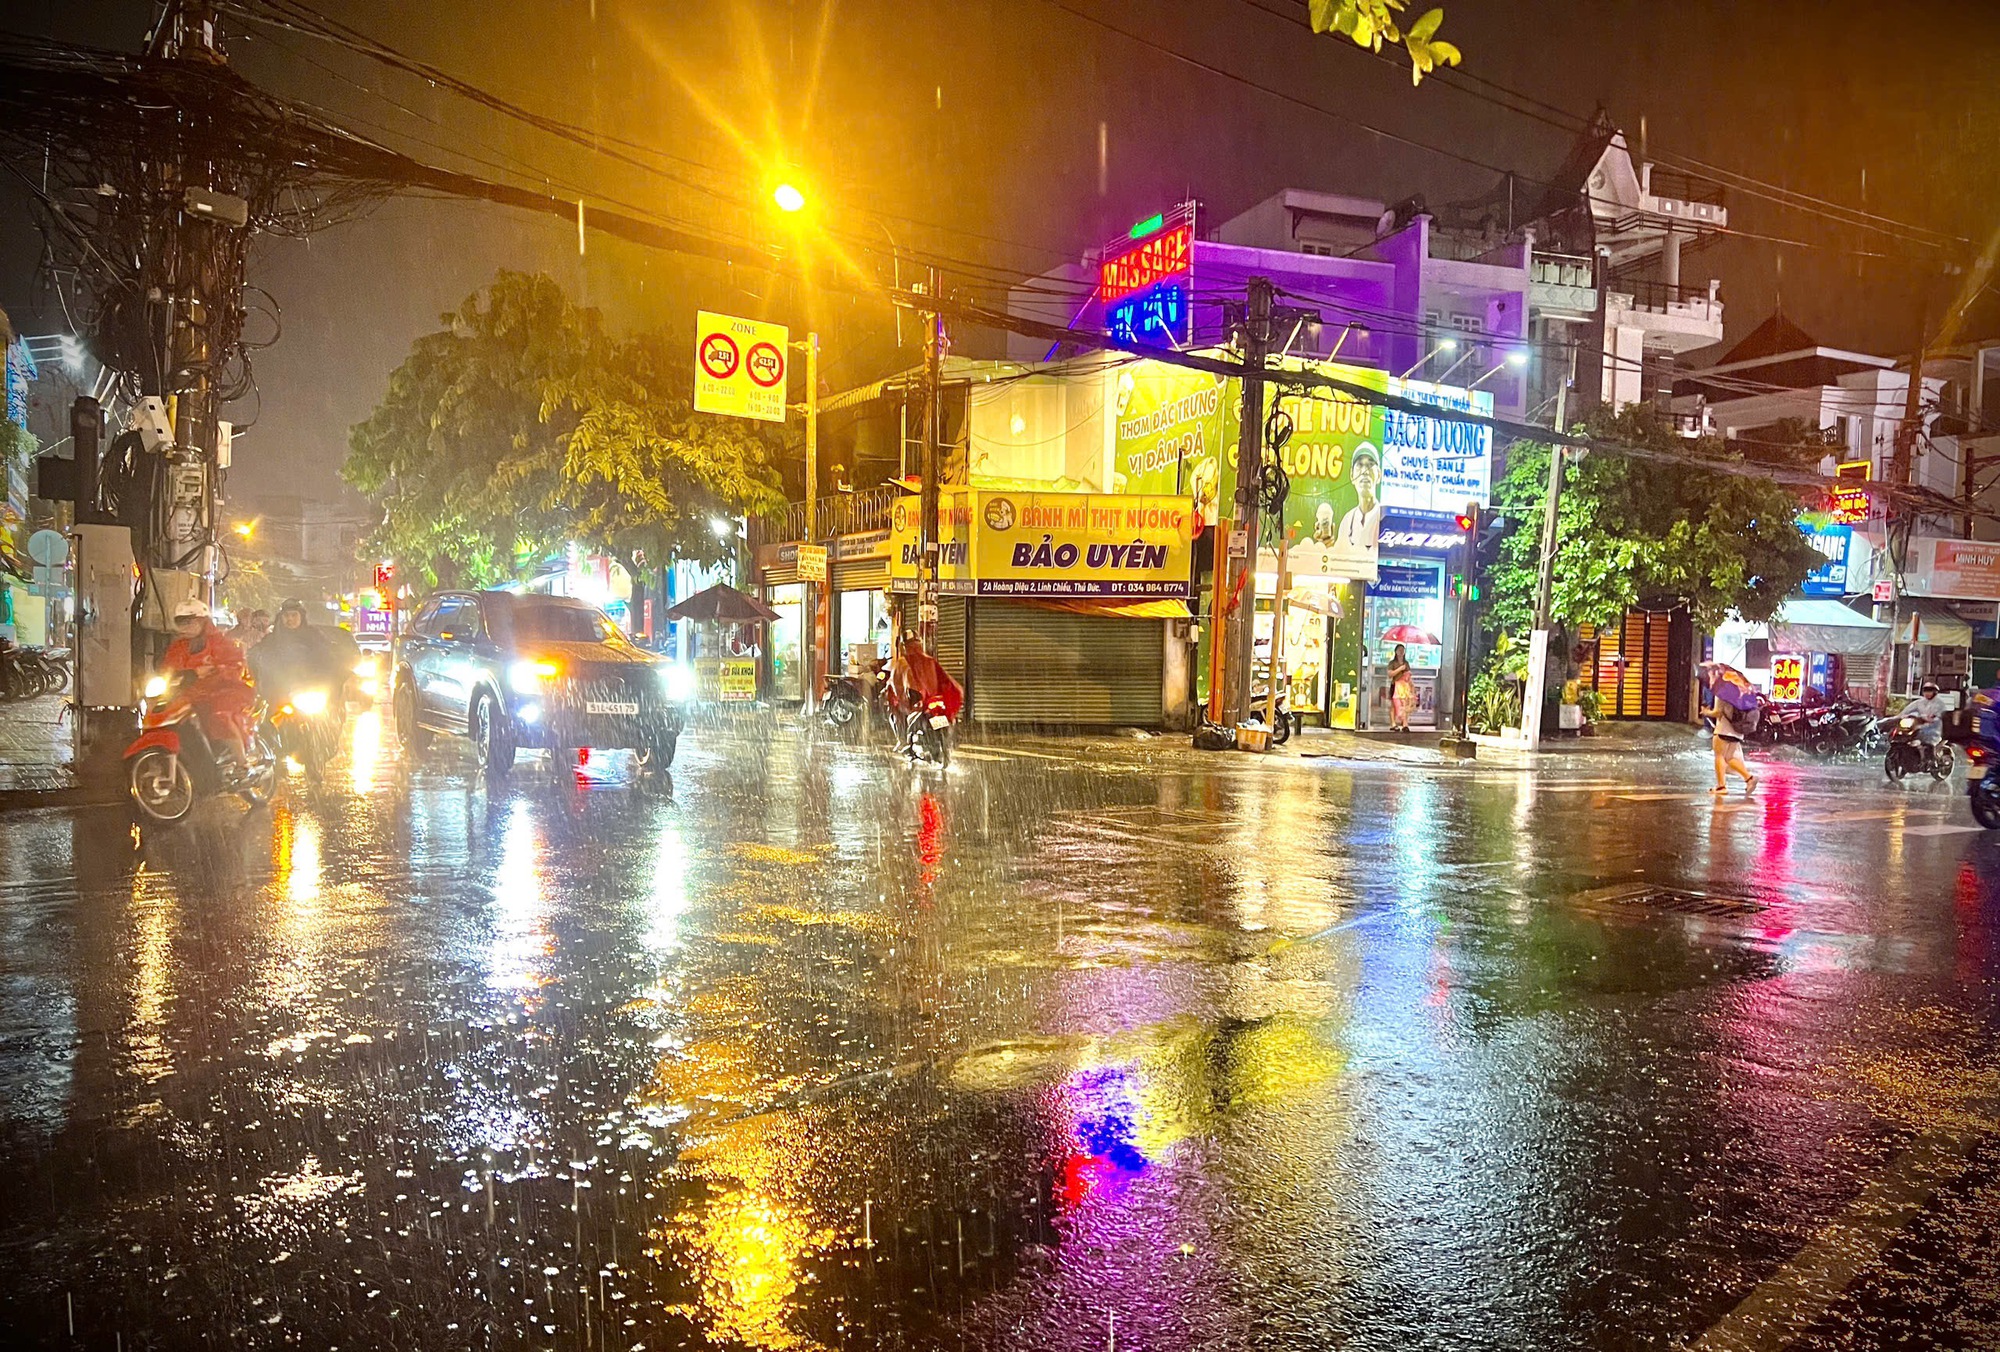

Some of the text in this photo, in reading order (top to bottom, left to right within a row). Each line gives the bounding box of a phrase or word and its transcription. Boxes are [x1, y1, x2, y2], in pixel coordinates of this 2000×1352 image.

[730, 322, 757, 336] ZONE
[1129, 455, 1142, 475] VỊ
[1283, 443, 1343, 479] LONG
[1021, 500, 1182, 537] BÁNH MÌ THỊT NƯỚNG
[1011, 534, 1168, 569] BẢO UYÊN
[1955, 553, 1995, 566] MINH HUY
[983, 582, 992, 591] 2A
[993, 582, 1013, 593] Hoàng
[1030, 582, 1036, 592] 2,
[1037, 582, 1051, 592] Linh
[1128, 583, 1144, 593] 034
